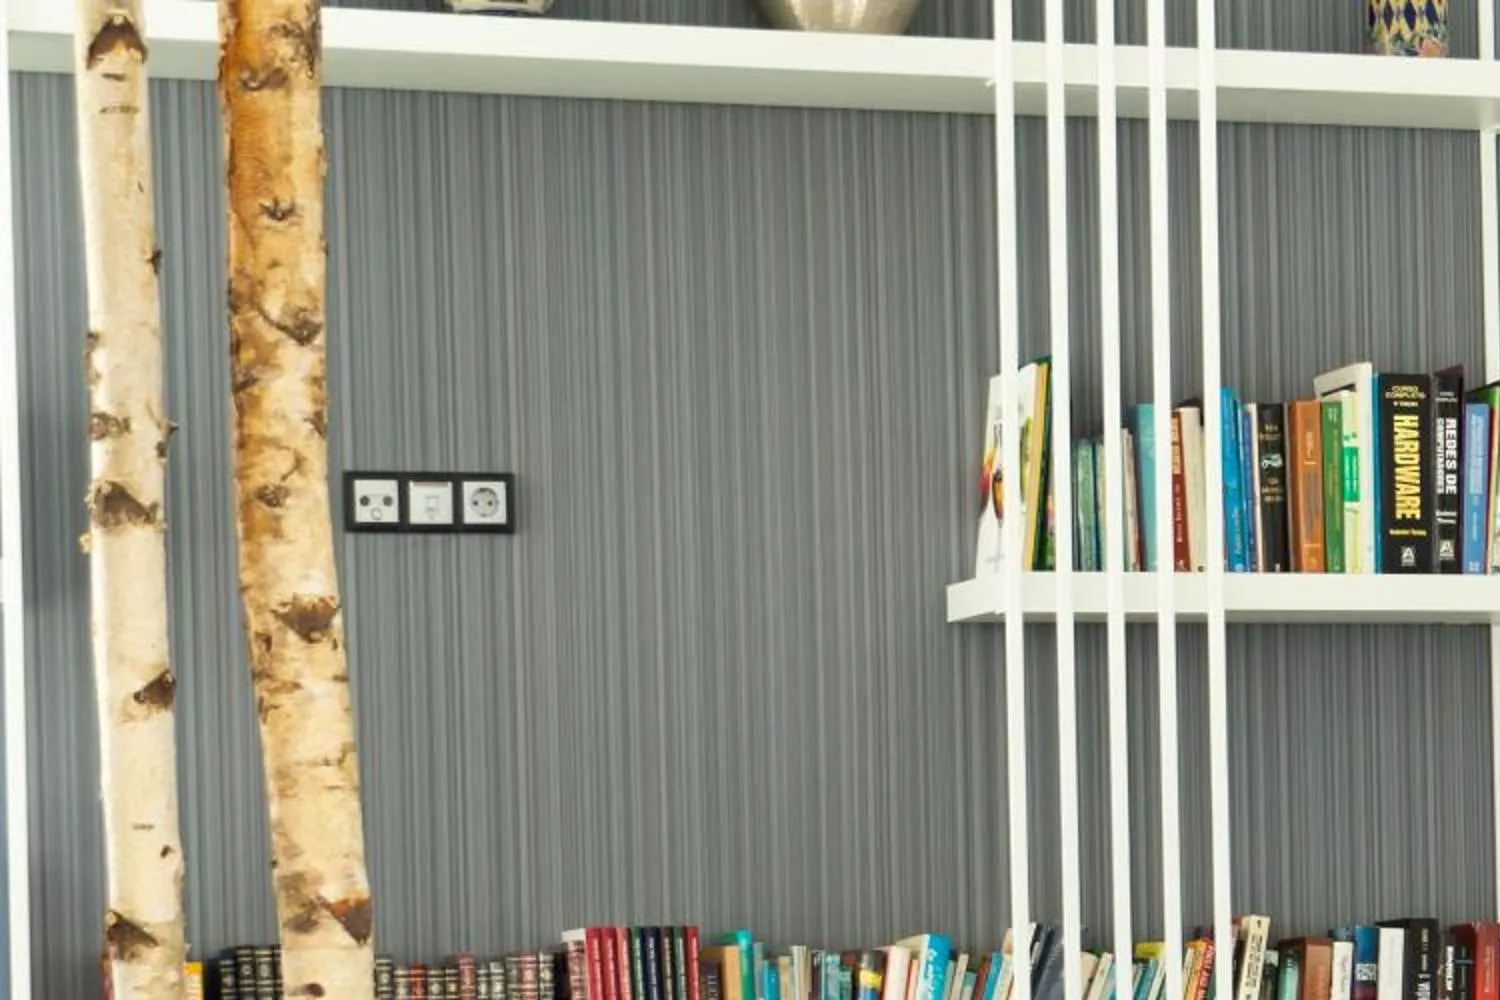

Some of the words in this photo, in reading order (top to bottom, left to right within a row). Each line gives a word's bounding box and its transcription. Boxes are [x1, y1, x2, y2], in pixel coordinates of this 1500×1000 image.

[1393, 414, 1421, 520] HARDWARE
[1445, 417, 1457, 470] REDES
[1445, 473, 1457, 495] DE
